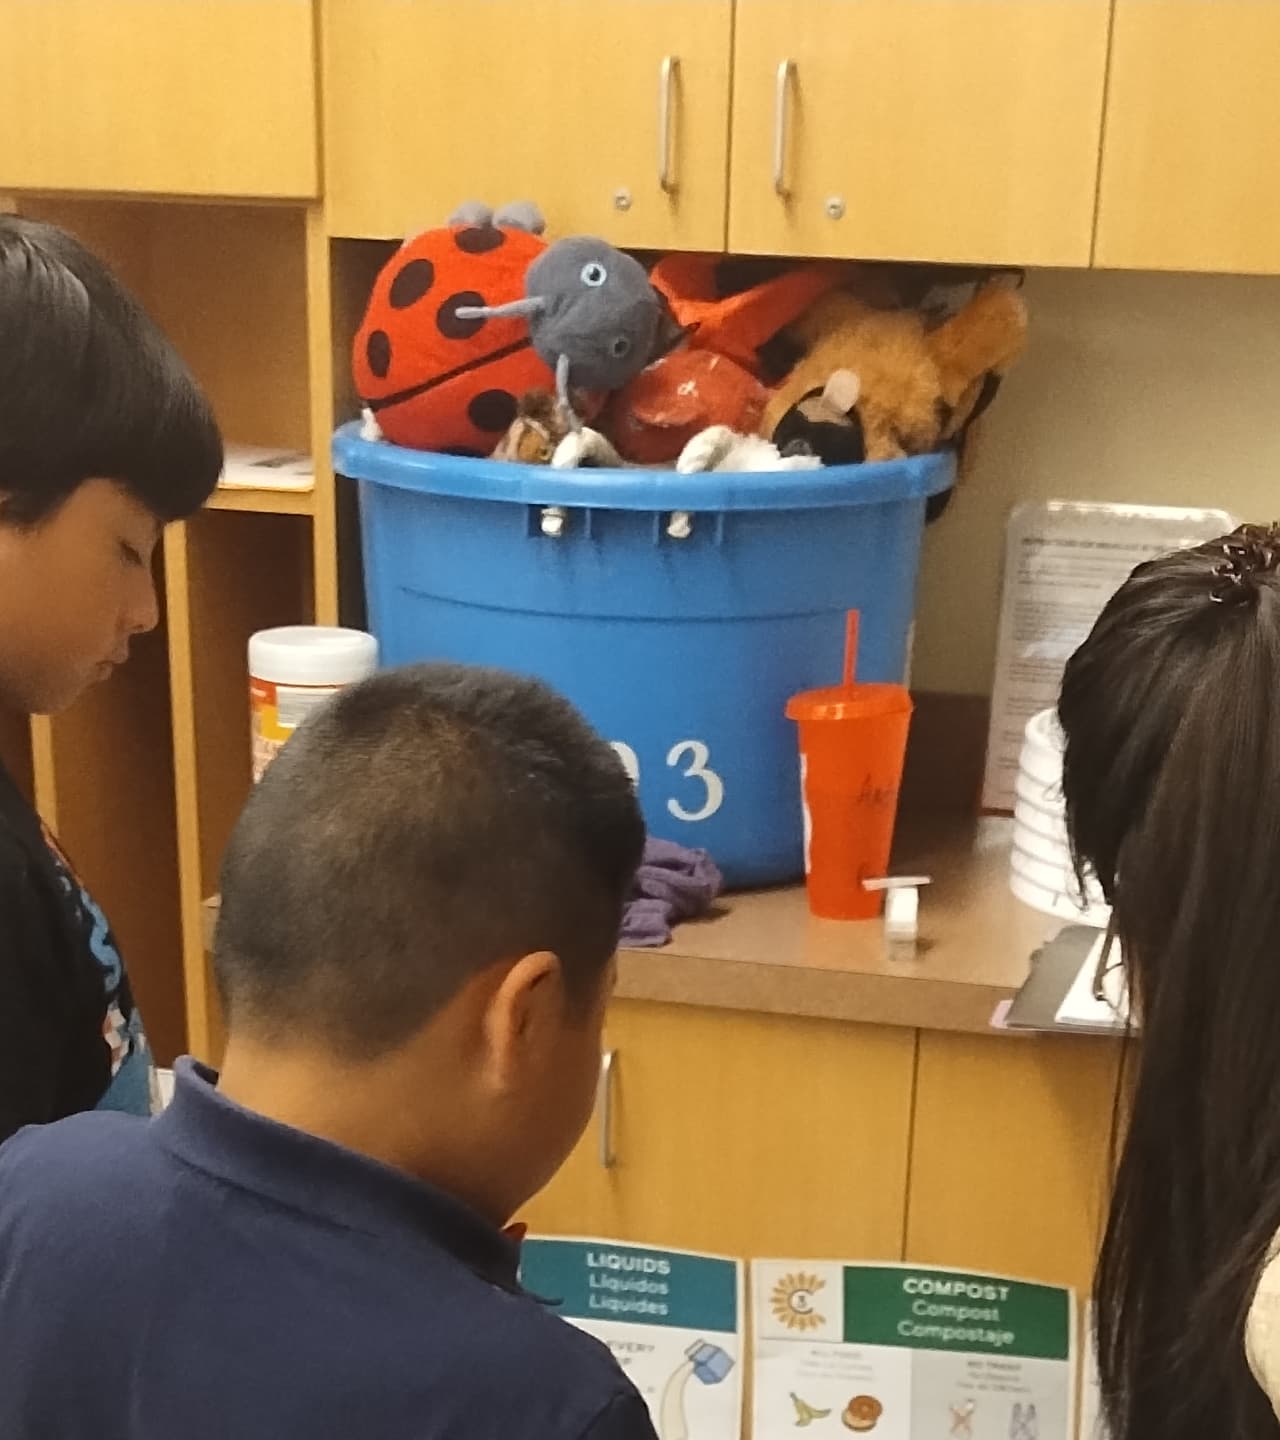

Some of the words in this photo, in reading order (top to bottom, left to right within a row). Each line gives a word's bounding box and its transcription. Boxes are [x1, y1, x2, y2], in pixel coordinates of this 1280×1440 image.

[586, 1252, 671, 1275] LIQUIDS
[902, 1278, 1009, 1302] COMPOST
[588, 1293, 669, 1316] Liquides
[911, 1299, 1000, 1323] Compost
[896, 1319, 1016, 1348] Compostaje
